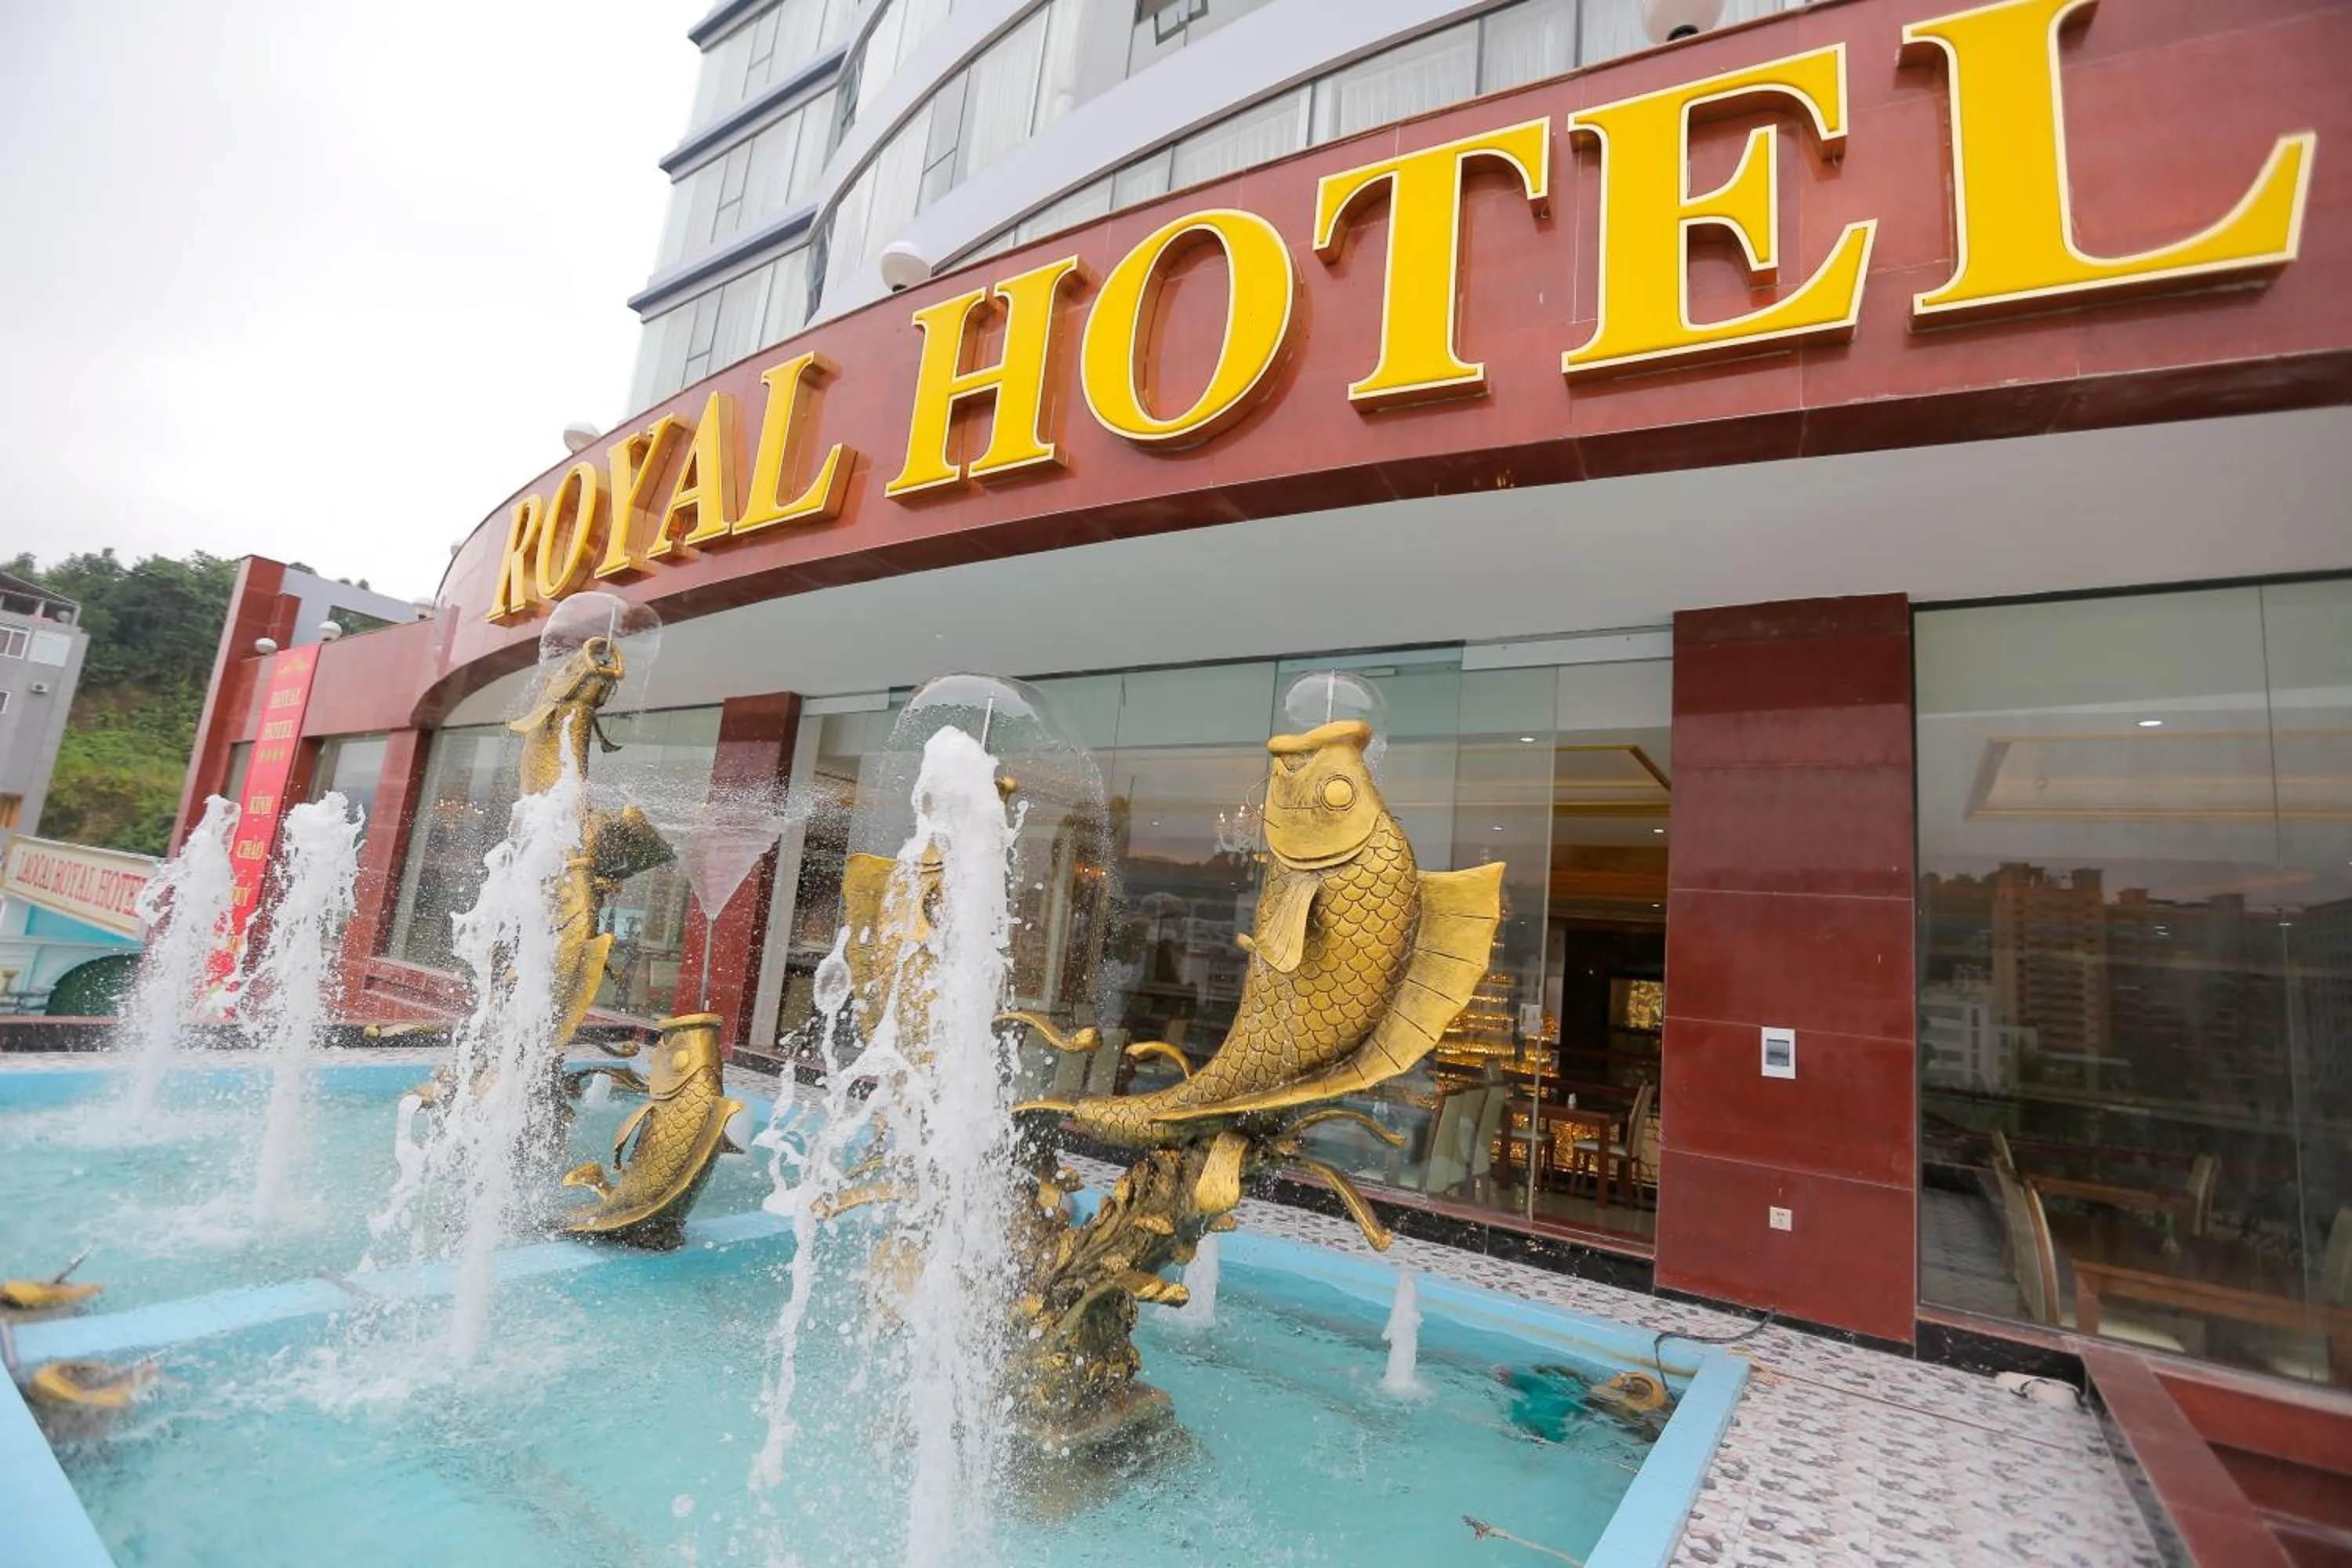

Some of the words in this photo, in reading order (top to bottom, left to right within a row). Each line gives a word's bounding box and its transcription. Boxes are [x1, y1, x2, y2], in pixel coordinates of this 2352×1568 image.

[485, 350, 848, 625] ROYAL
[884, 0, 2318, 502] HOTEL
[263, 719, 295, 741] HOTEL
[50, 858, 95, 903] ROYAL
[93, 868, 149, 918] HOTE
